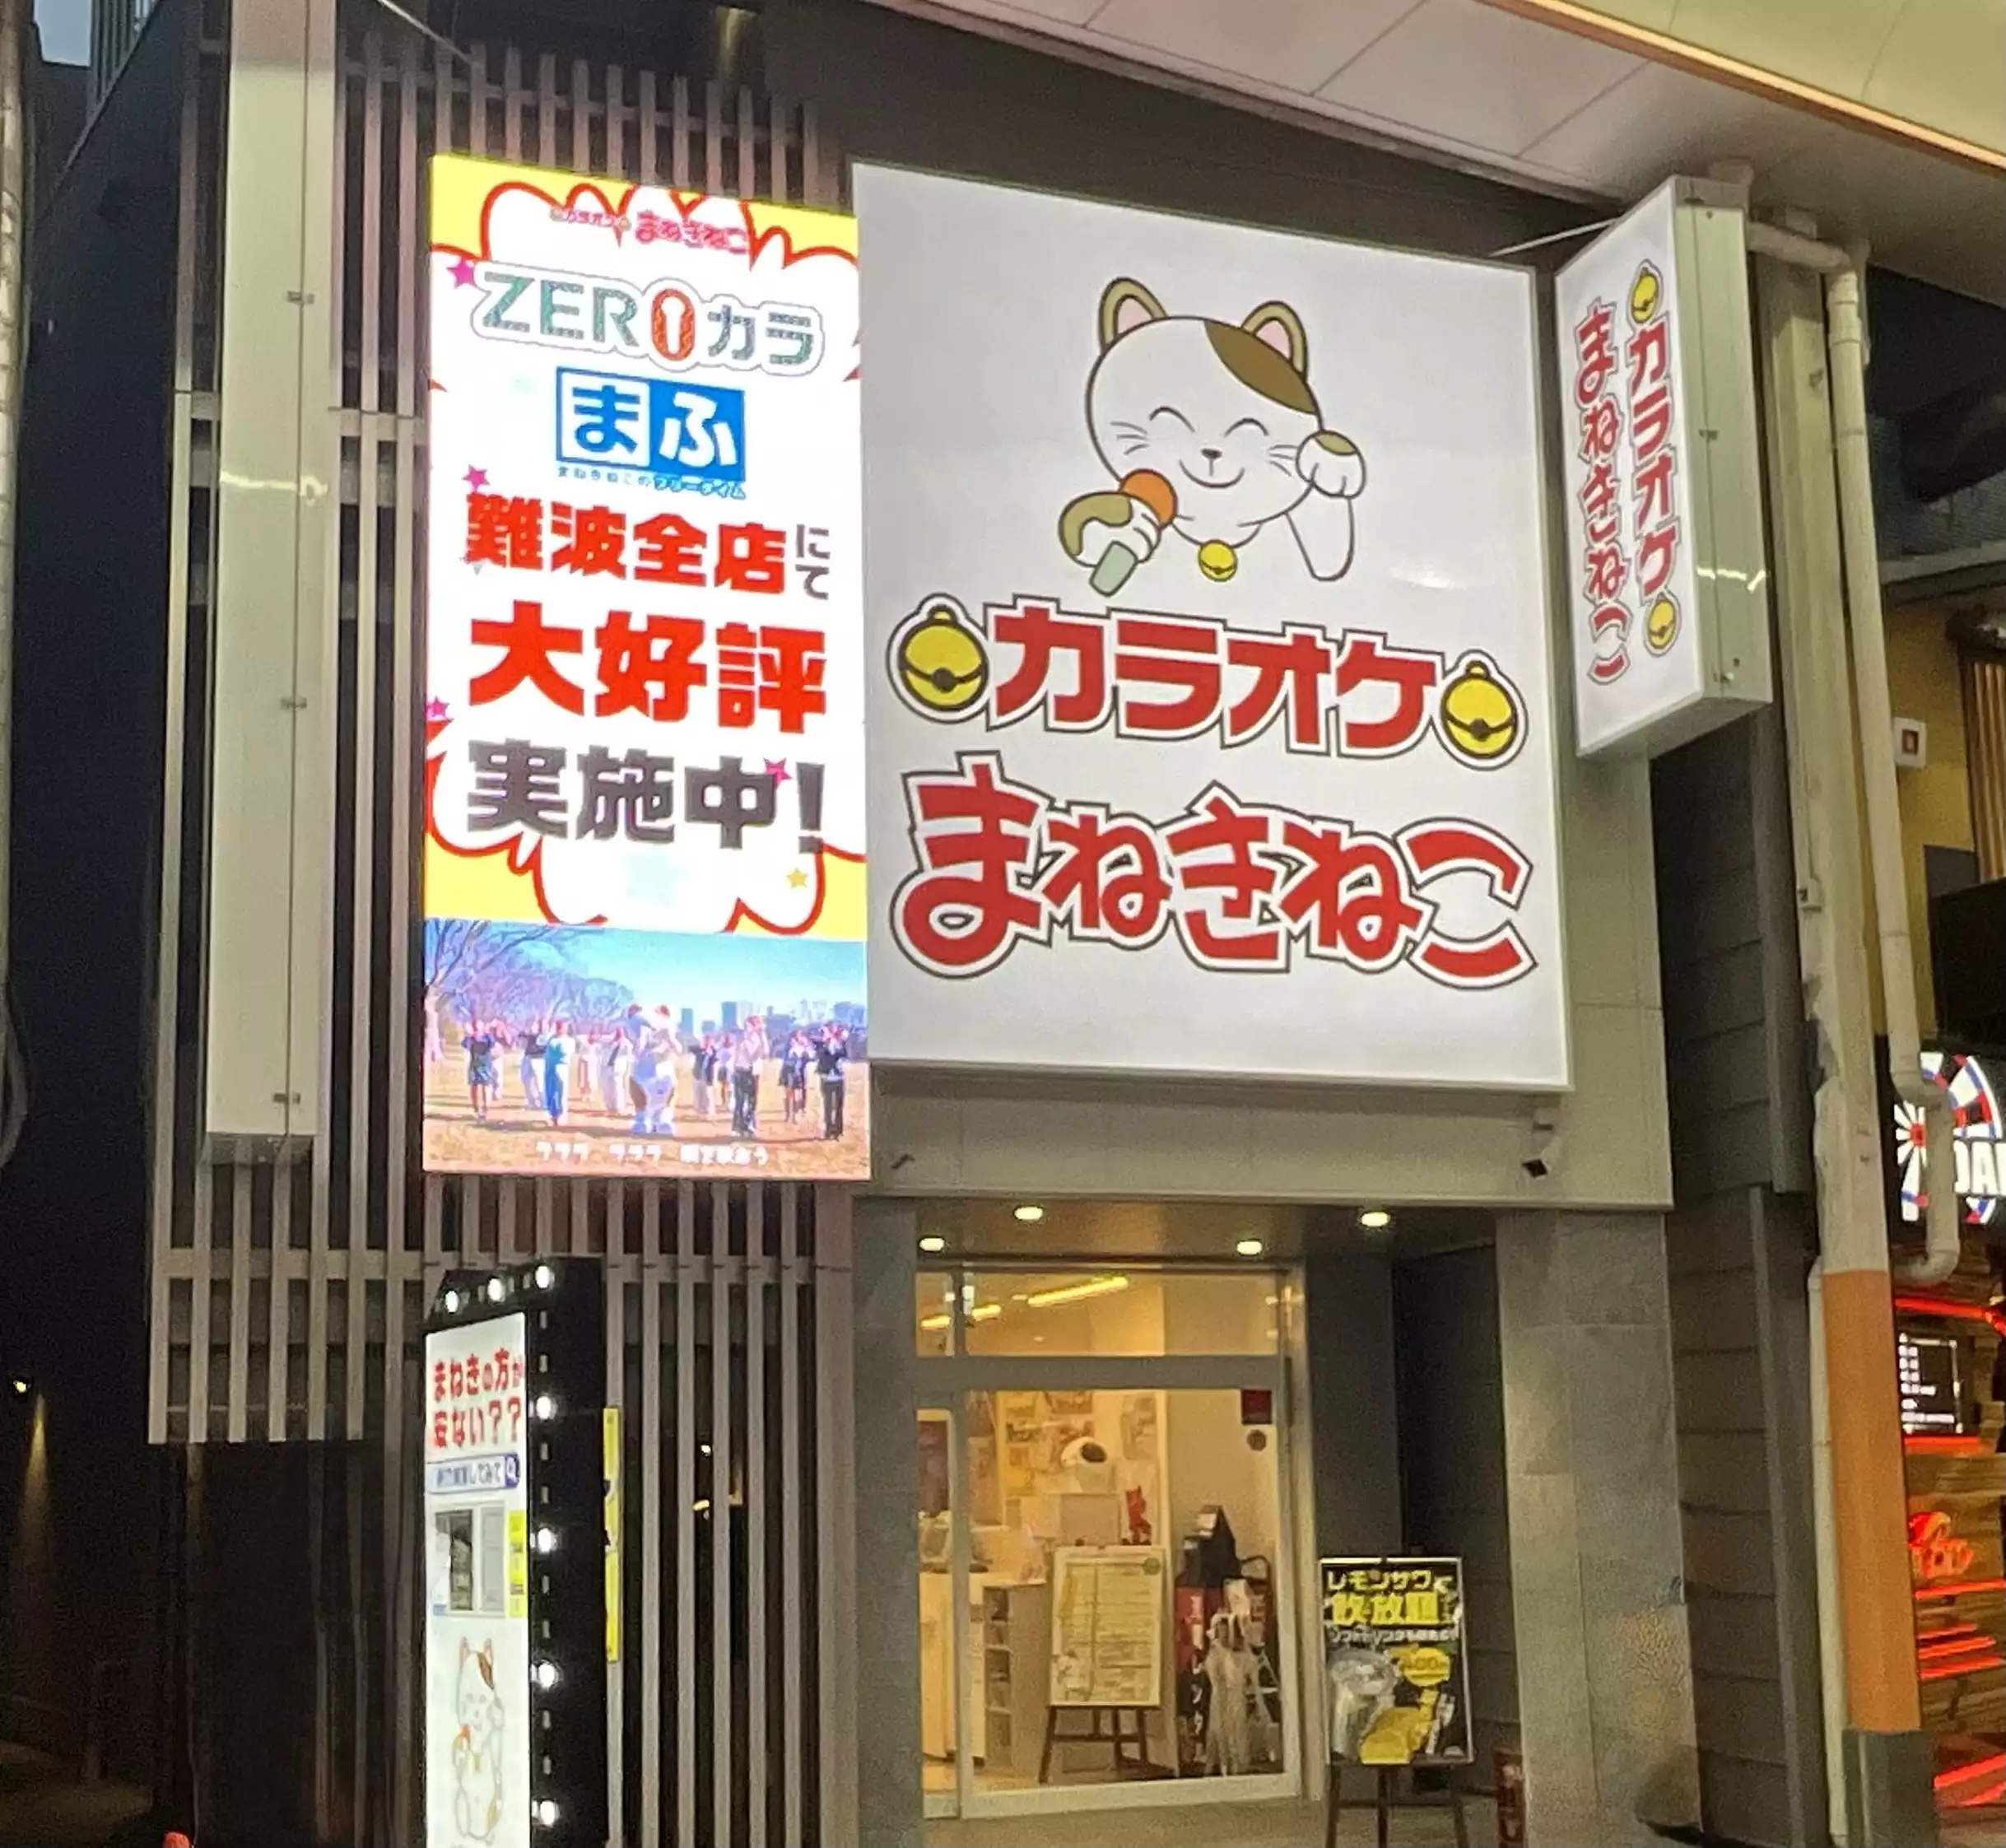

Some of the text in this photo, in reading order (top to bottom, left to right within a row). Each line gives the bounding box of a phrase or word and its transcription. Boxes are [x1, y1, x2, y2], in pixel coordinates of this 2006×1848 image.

[571, 384, 738, 468] まふ
[1575, 305, 1628, 680] まねきねこ
[1628, 314, 1679, 599] カラオケ
[468, 599, 827, 734] 大好評
[991, 601, 1441, 751] カラオケ
[900, 759, 1527, 982] まねきねこ
